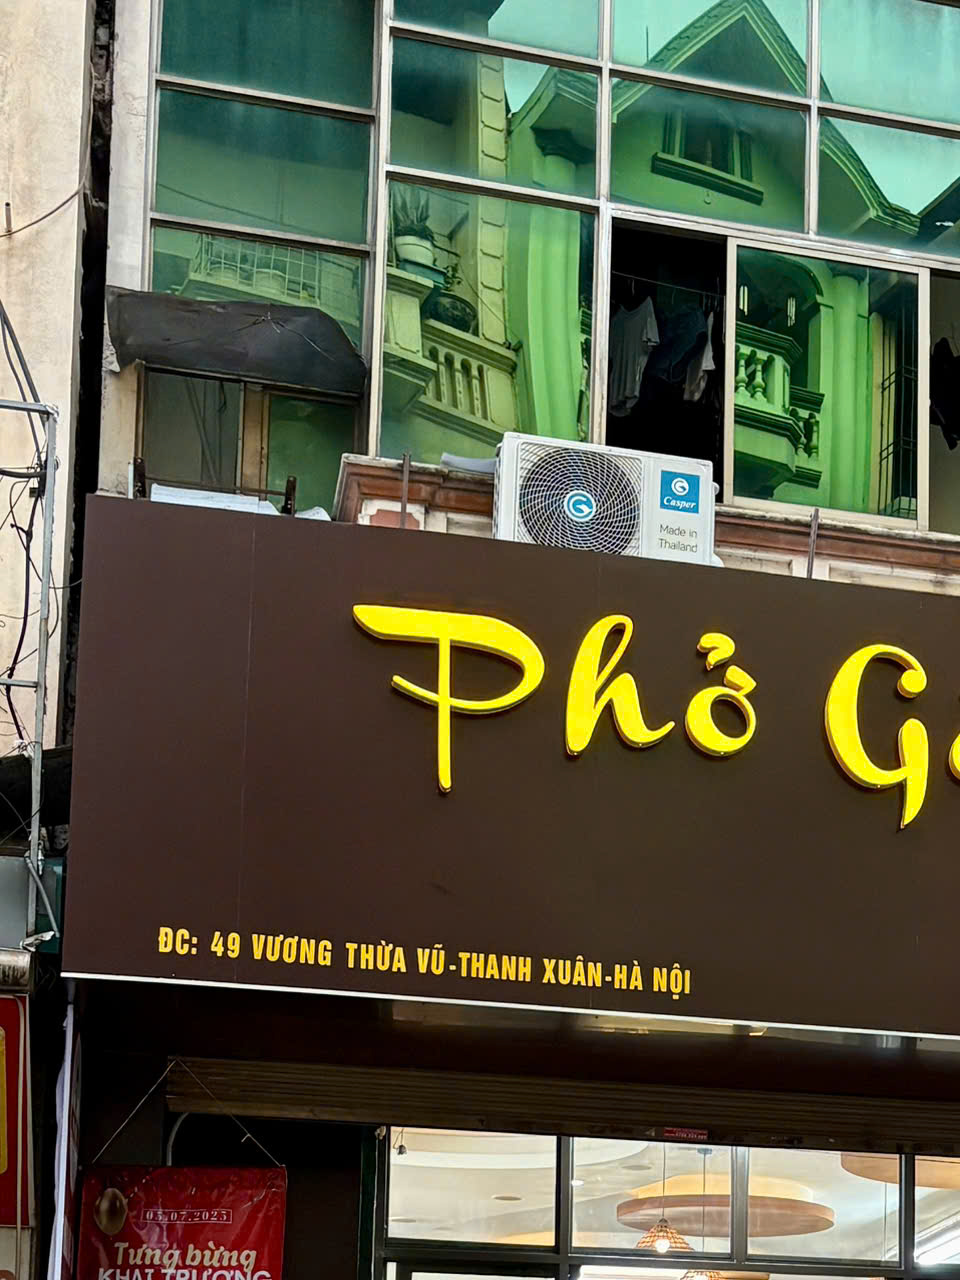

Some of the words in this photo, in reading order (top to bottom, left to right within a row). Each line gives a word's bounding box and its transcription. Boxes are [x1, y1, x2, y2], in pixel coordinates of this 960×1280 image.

[663, 496, 697, 510] Casper
[660, 524, 686, 537] Made
[689, 528, 698, 539] in
[659, 538, 698, 553] Thailand
[352, 604, 757, 793] Phở
[157, 926, 198, 955] ĐC:
[210, 930, 242, 959] 49
[251, 933, 333, 967] VƯƠNG
[345, 939, 408, 973] THỪA
[652, 962, 692, 1001] NỘI
[114, 1242, 181, 1270] Tưng
[185, 1240, 258, 1272] bừng
